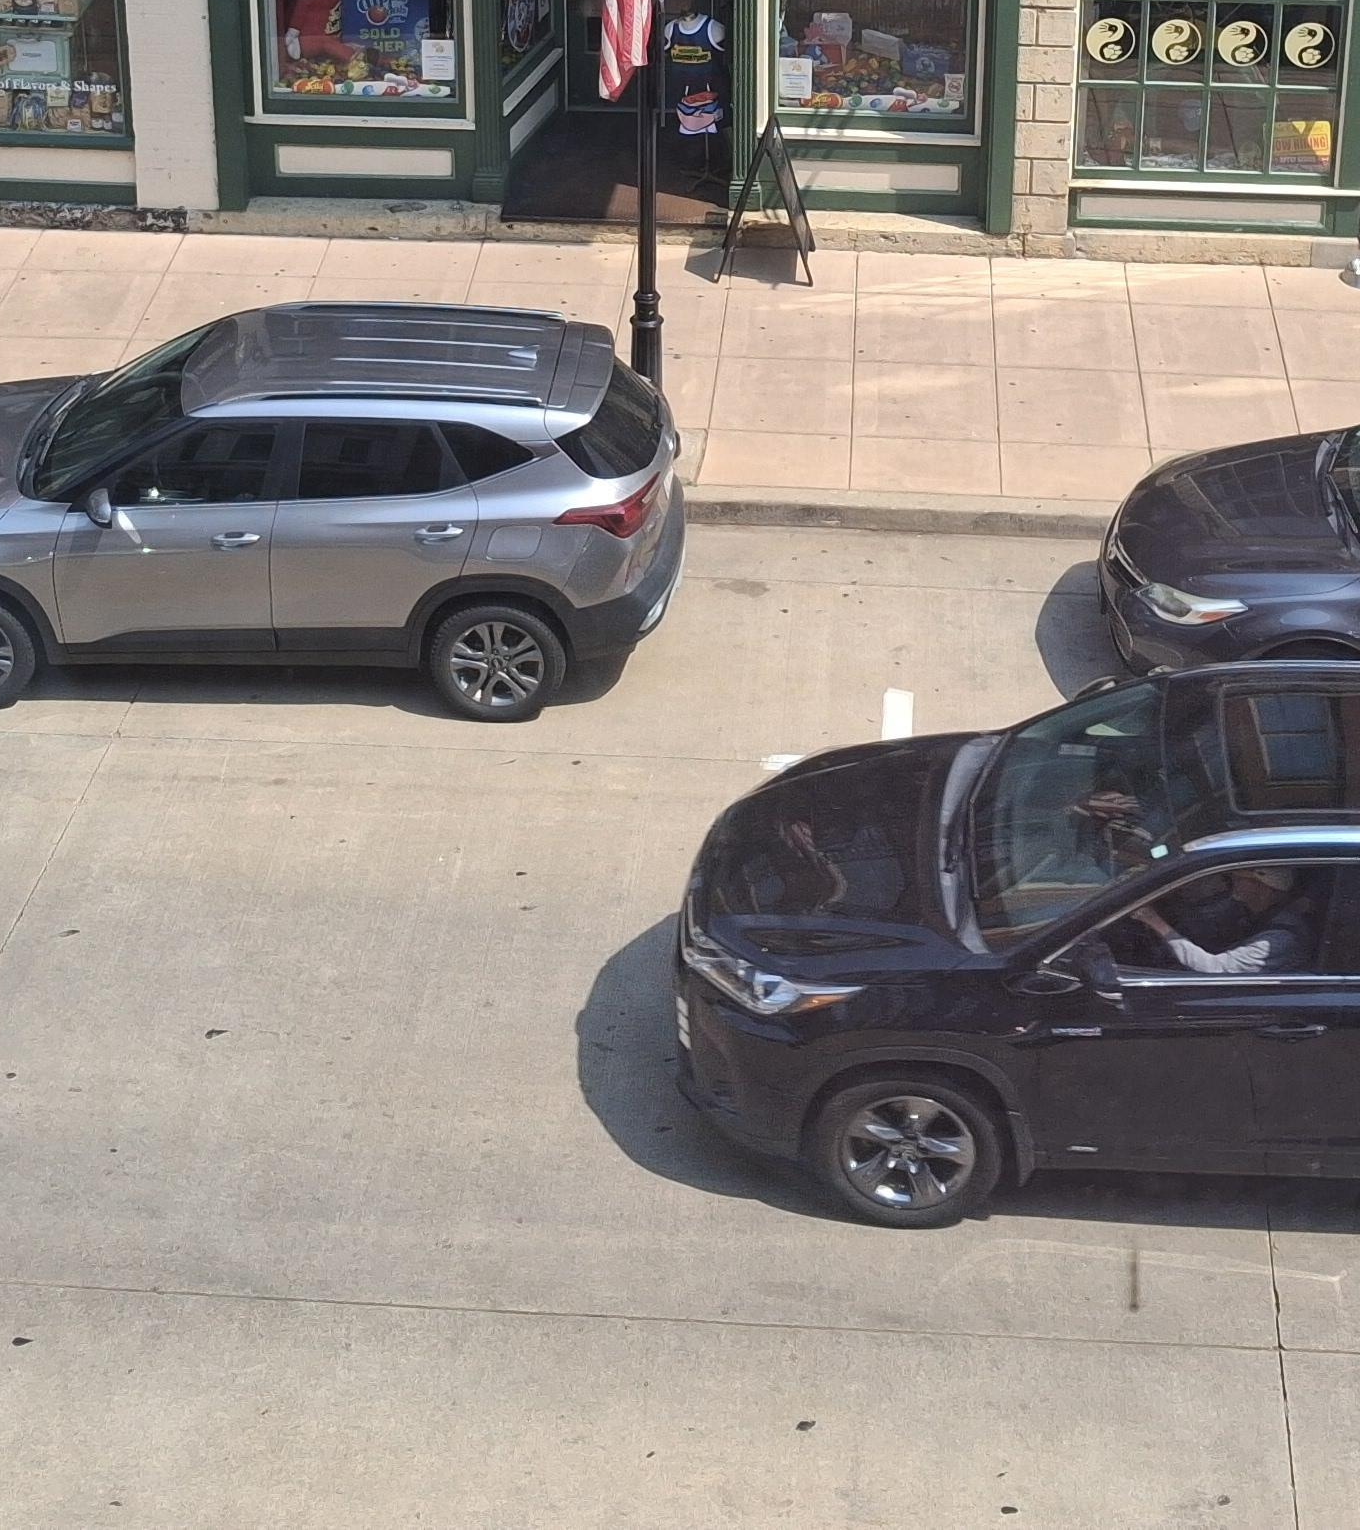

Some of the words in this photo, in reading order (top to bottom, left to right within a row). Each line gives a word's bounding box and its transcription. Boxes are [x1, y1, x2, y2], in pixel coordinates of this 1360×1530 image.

[359, 27, 401, 40] SOLD
[373, 40, 408, 54] HER
[12, 78, 60, 92] Flavors
[73, 80, 117, 96] Shapes
